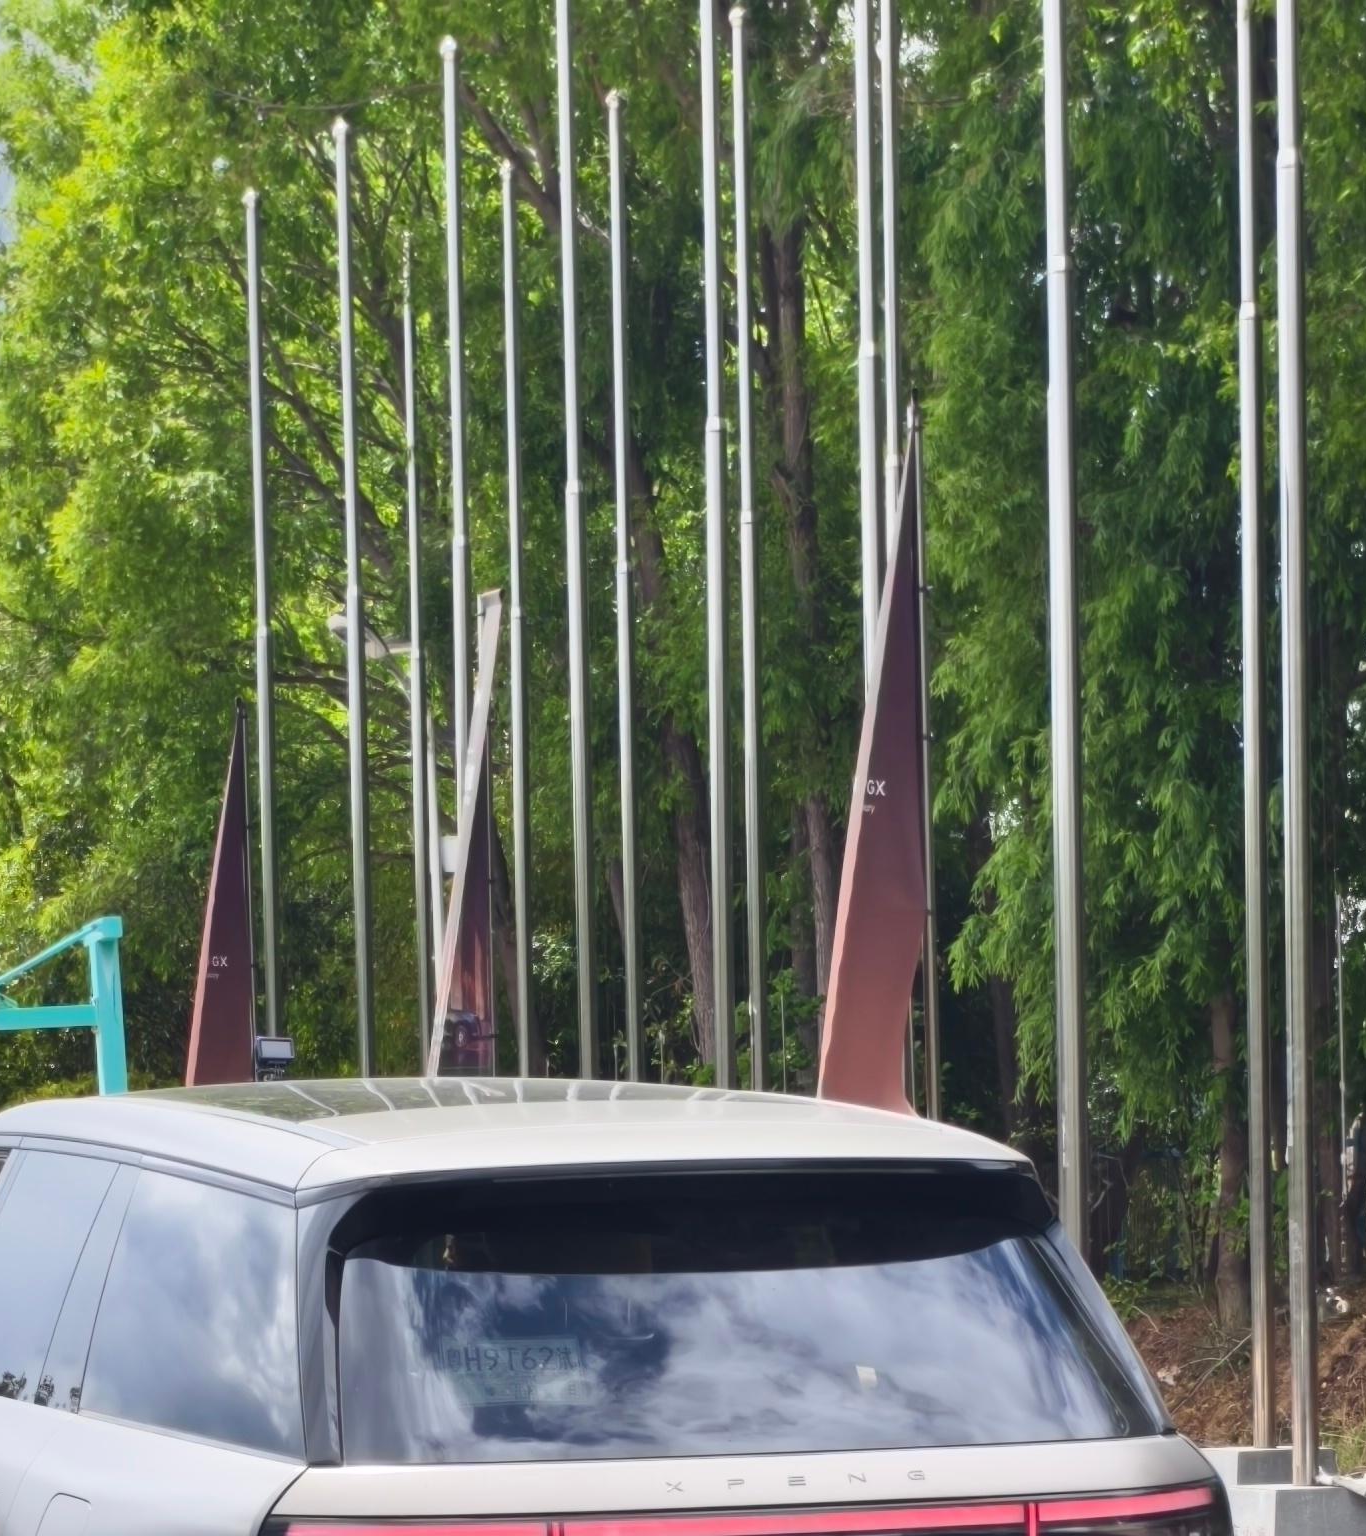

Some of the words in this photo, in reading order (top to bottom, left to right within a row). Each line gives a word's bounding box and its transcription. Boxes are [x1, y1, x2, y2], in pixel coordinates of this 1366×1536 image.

[866, 778, 887, 797] GX
[212, 955, 229, 967] GX
[665, 1470, 928, 1493] XPENG
